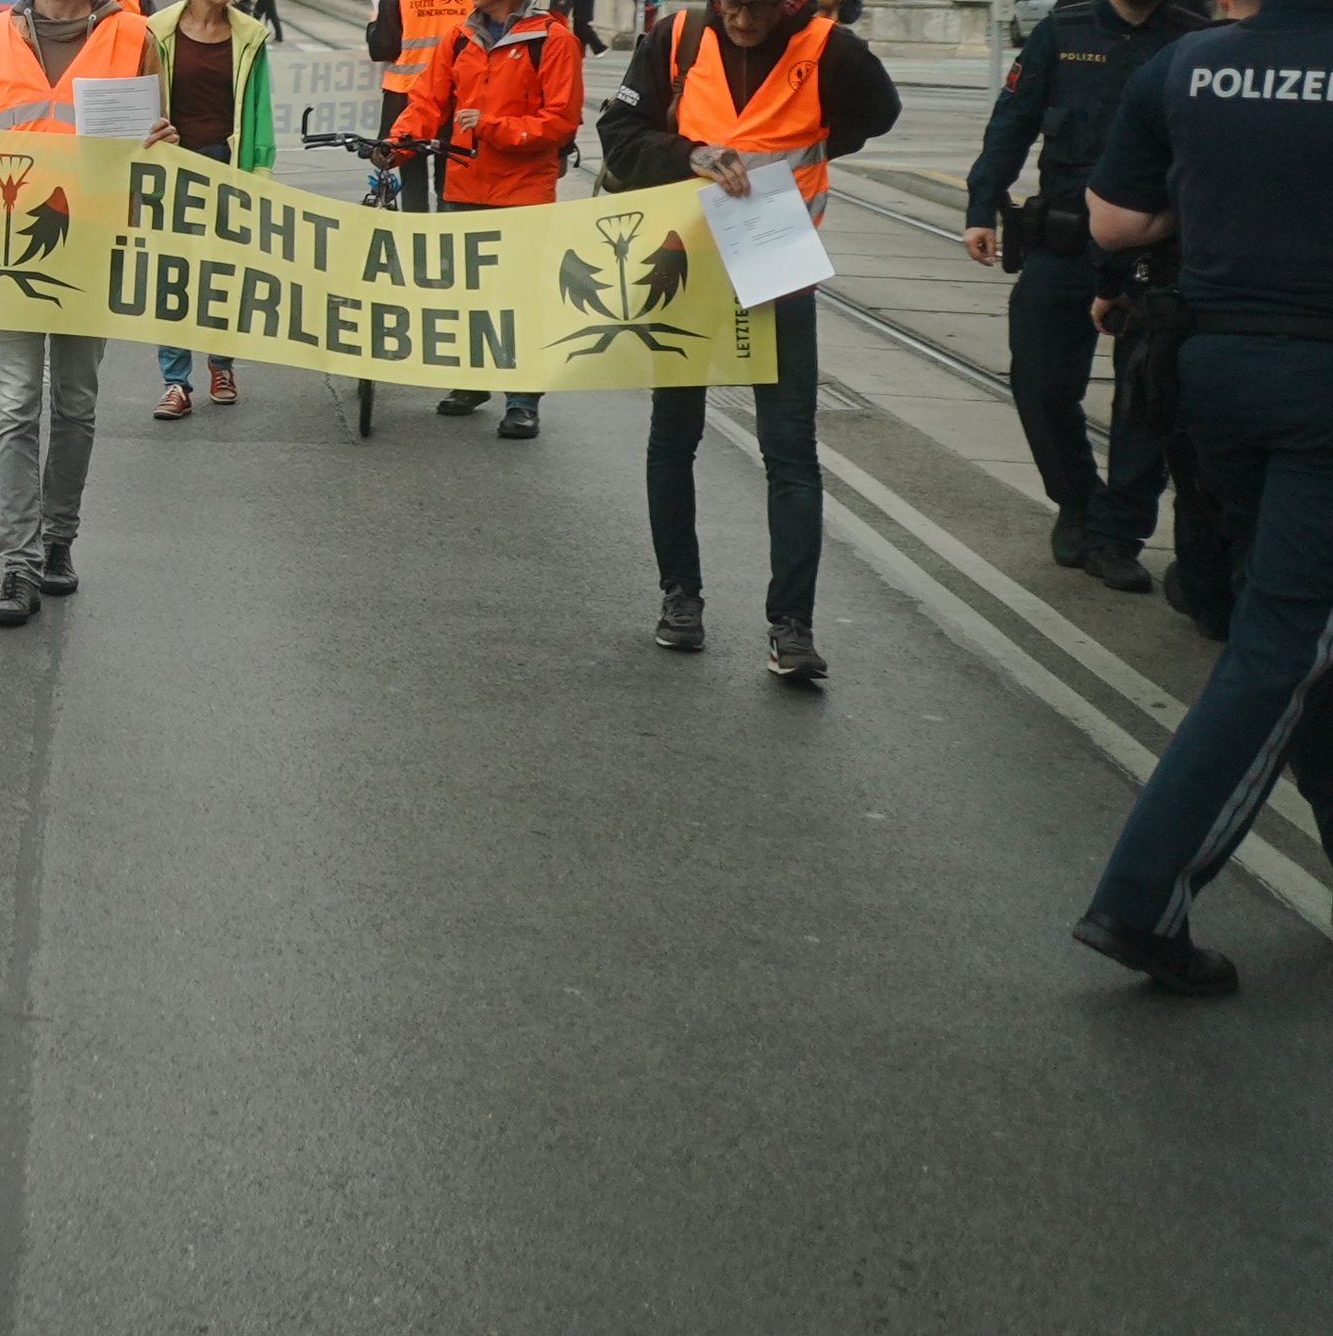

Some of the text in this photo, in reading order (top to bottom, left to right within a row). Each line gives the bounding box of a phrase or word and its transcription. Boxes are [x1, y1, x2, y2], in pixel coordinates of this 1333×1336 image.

[1060, 52, 1108, 63] POLIZEI
[128, 162, 502, 290] RECHT AUF
[108, 235, 517, 370] ÜBERLEBEN
[735, 309, 751, 358] LETZTE
